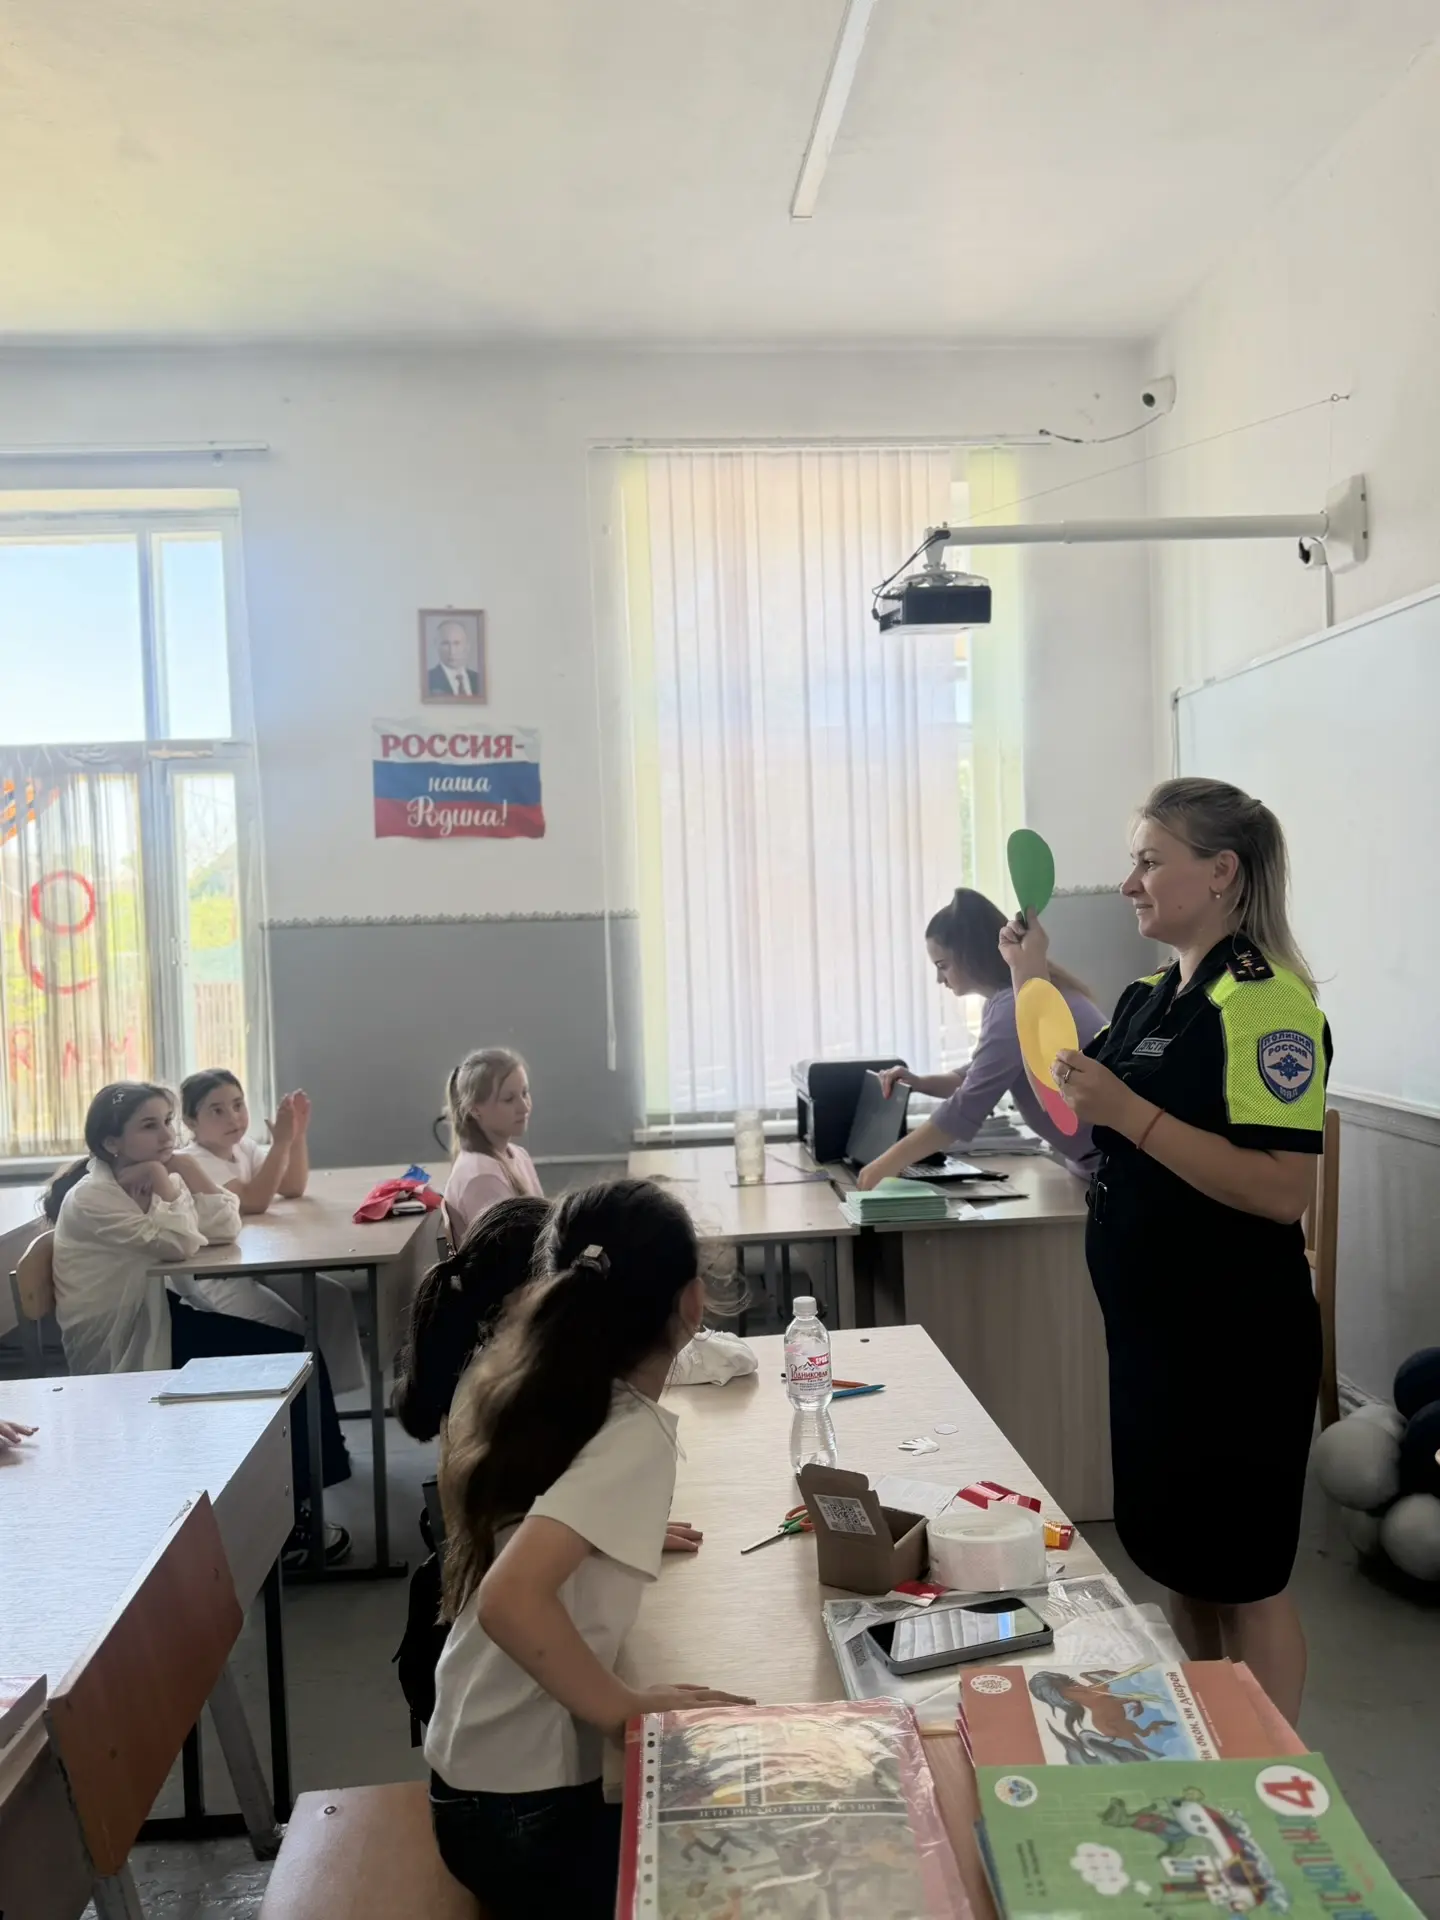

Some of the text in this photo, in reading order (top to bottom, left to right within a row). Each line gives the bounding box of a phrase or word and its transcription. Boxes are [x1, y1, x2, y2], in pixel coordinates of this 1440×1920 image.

[381, 733, 525, 759] РОССИЯ-
[428, 775, 491, 793] наша
[406, 795, 509, 836] Родина!
[1263, 1032, 1311, 1050] ПОЛИЦИЯ
[1268, 1044, 1308, 1059] РОССИЯ
[1183, 1707, 1196, 1720] ни
[1262, 1775, 1316, 1809] 4
